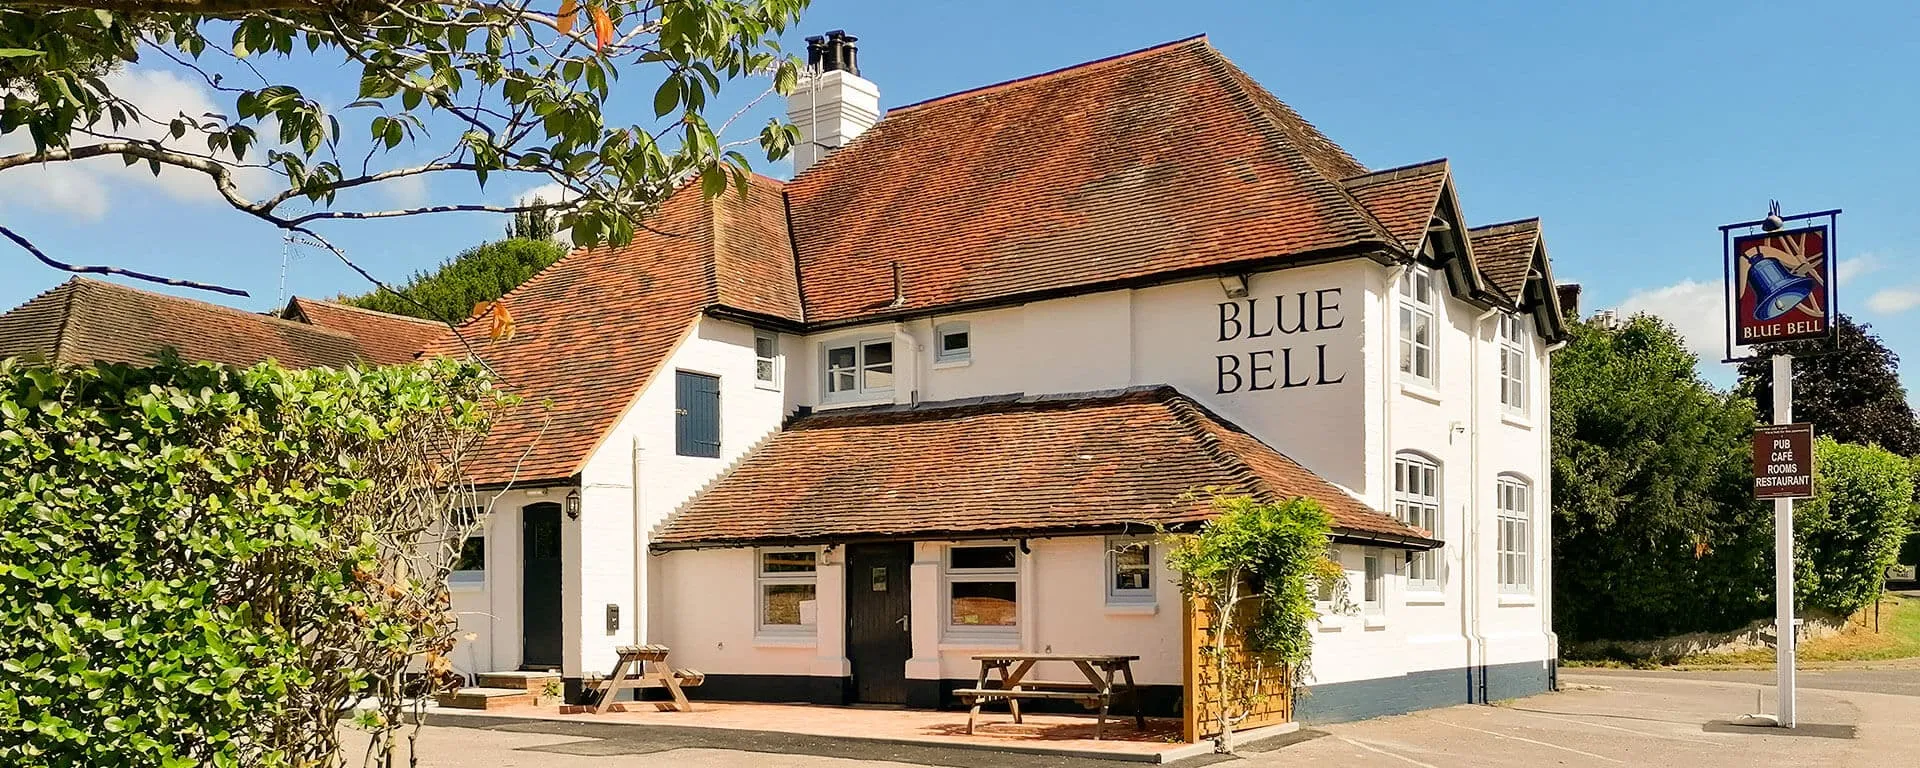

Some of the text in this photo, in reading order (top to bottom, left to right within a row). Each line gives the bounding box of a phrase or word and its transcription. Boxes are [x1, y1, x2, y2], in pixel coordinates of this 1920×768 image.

[1216, 288, 1345, 342] BLUE
[1744, 320, 1822, 338] BLUE BELL
[1216, 344, 1347, 395] BELL
[1773, 439, 1791, 449] PUB
[1771, 449, 1793, 462] CAFÉ
[1767, 463, 1798, 474] ROOMS
[1755, 475, 1810, 487] RESTAURANT
